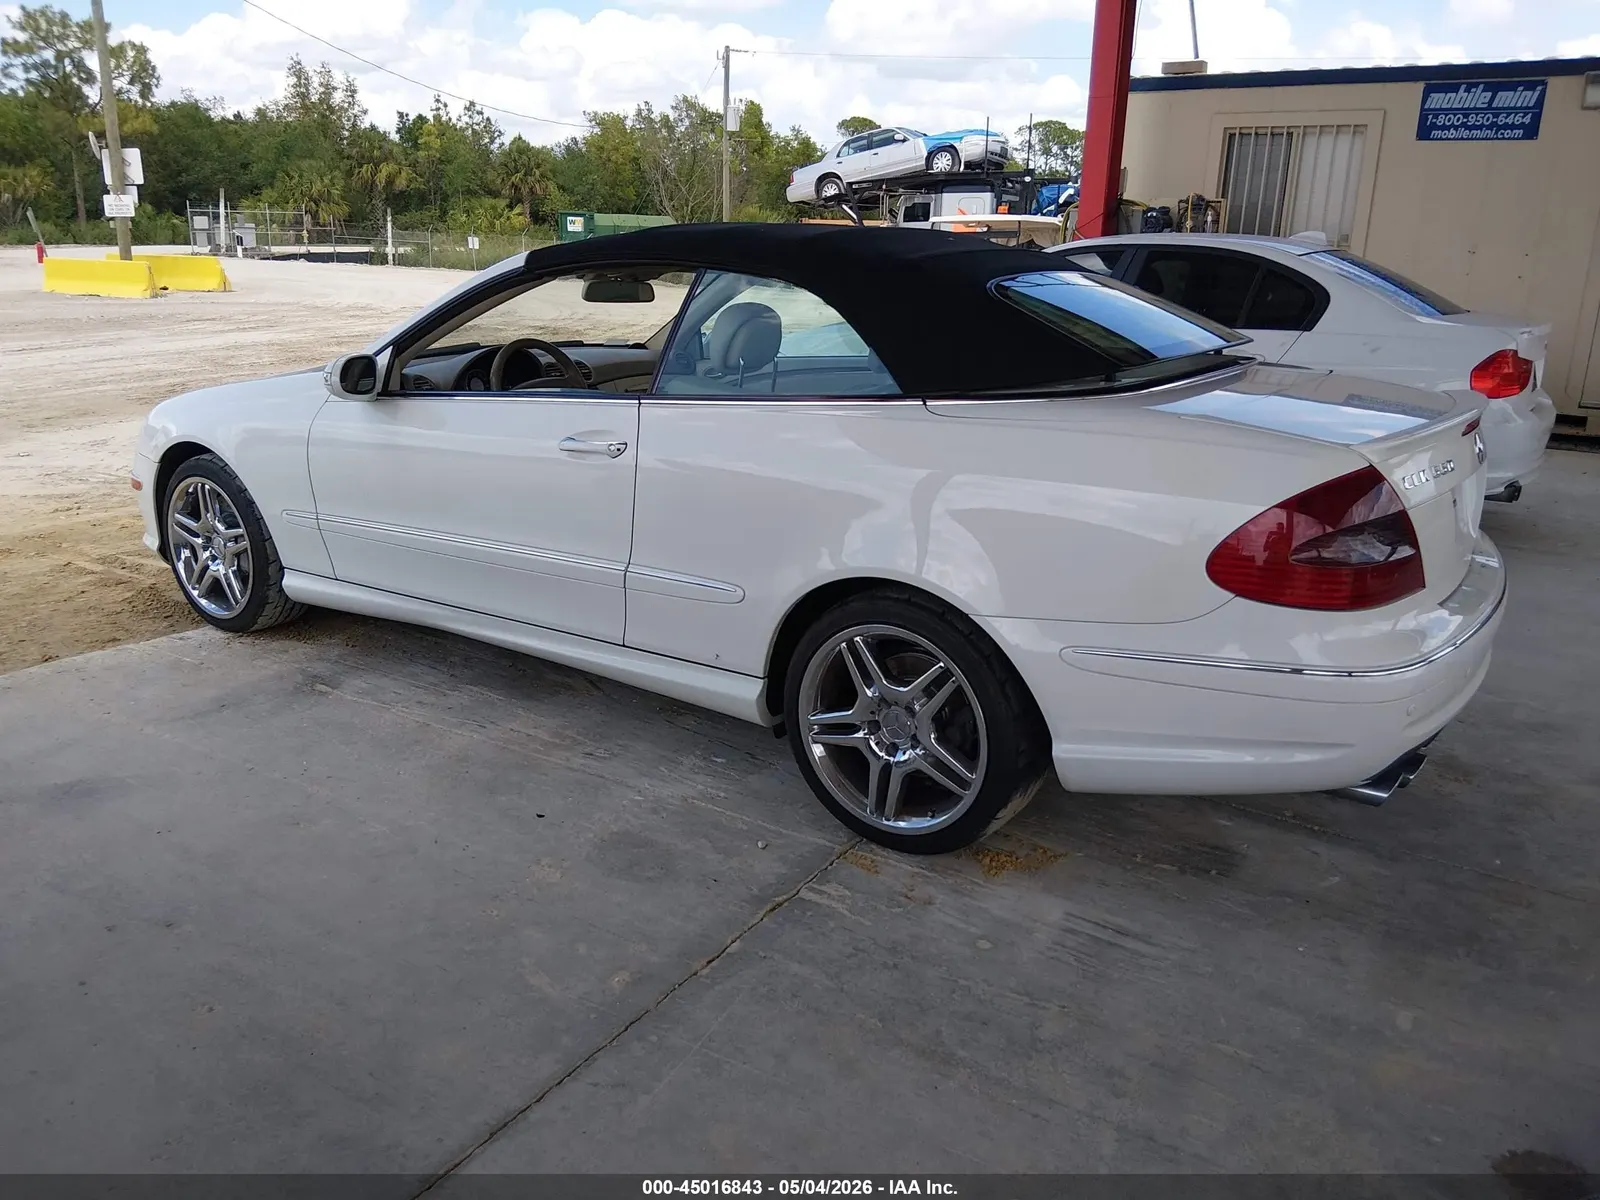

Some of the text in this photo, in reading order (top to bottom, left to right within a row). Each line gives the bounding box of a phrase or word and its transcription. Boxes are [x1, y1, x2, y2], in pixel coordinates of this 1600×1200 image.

[1424, 84, 1543, 109] mobile mini
[1426, 113, 1532, 126] 1-800-950-6464
[1430, 127, 1523, 139] mobilemini.com
[1402, 469, 1430, 490] CLK
